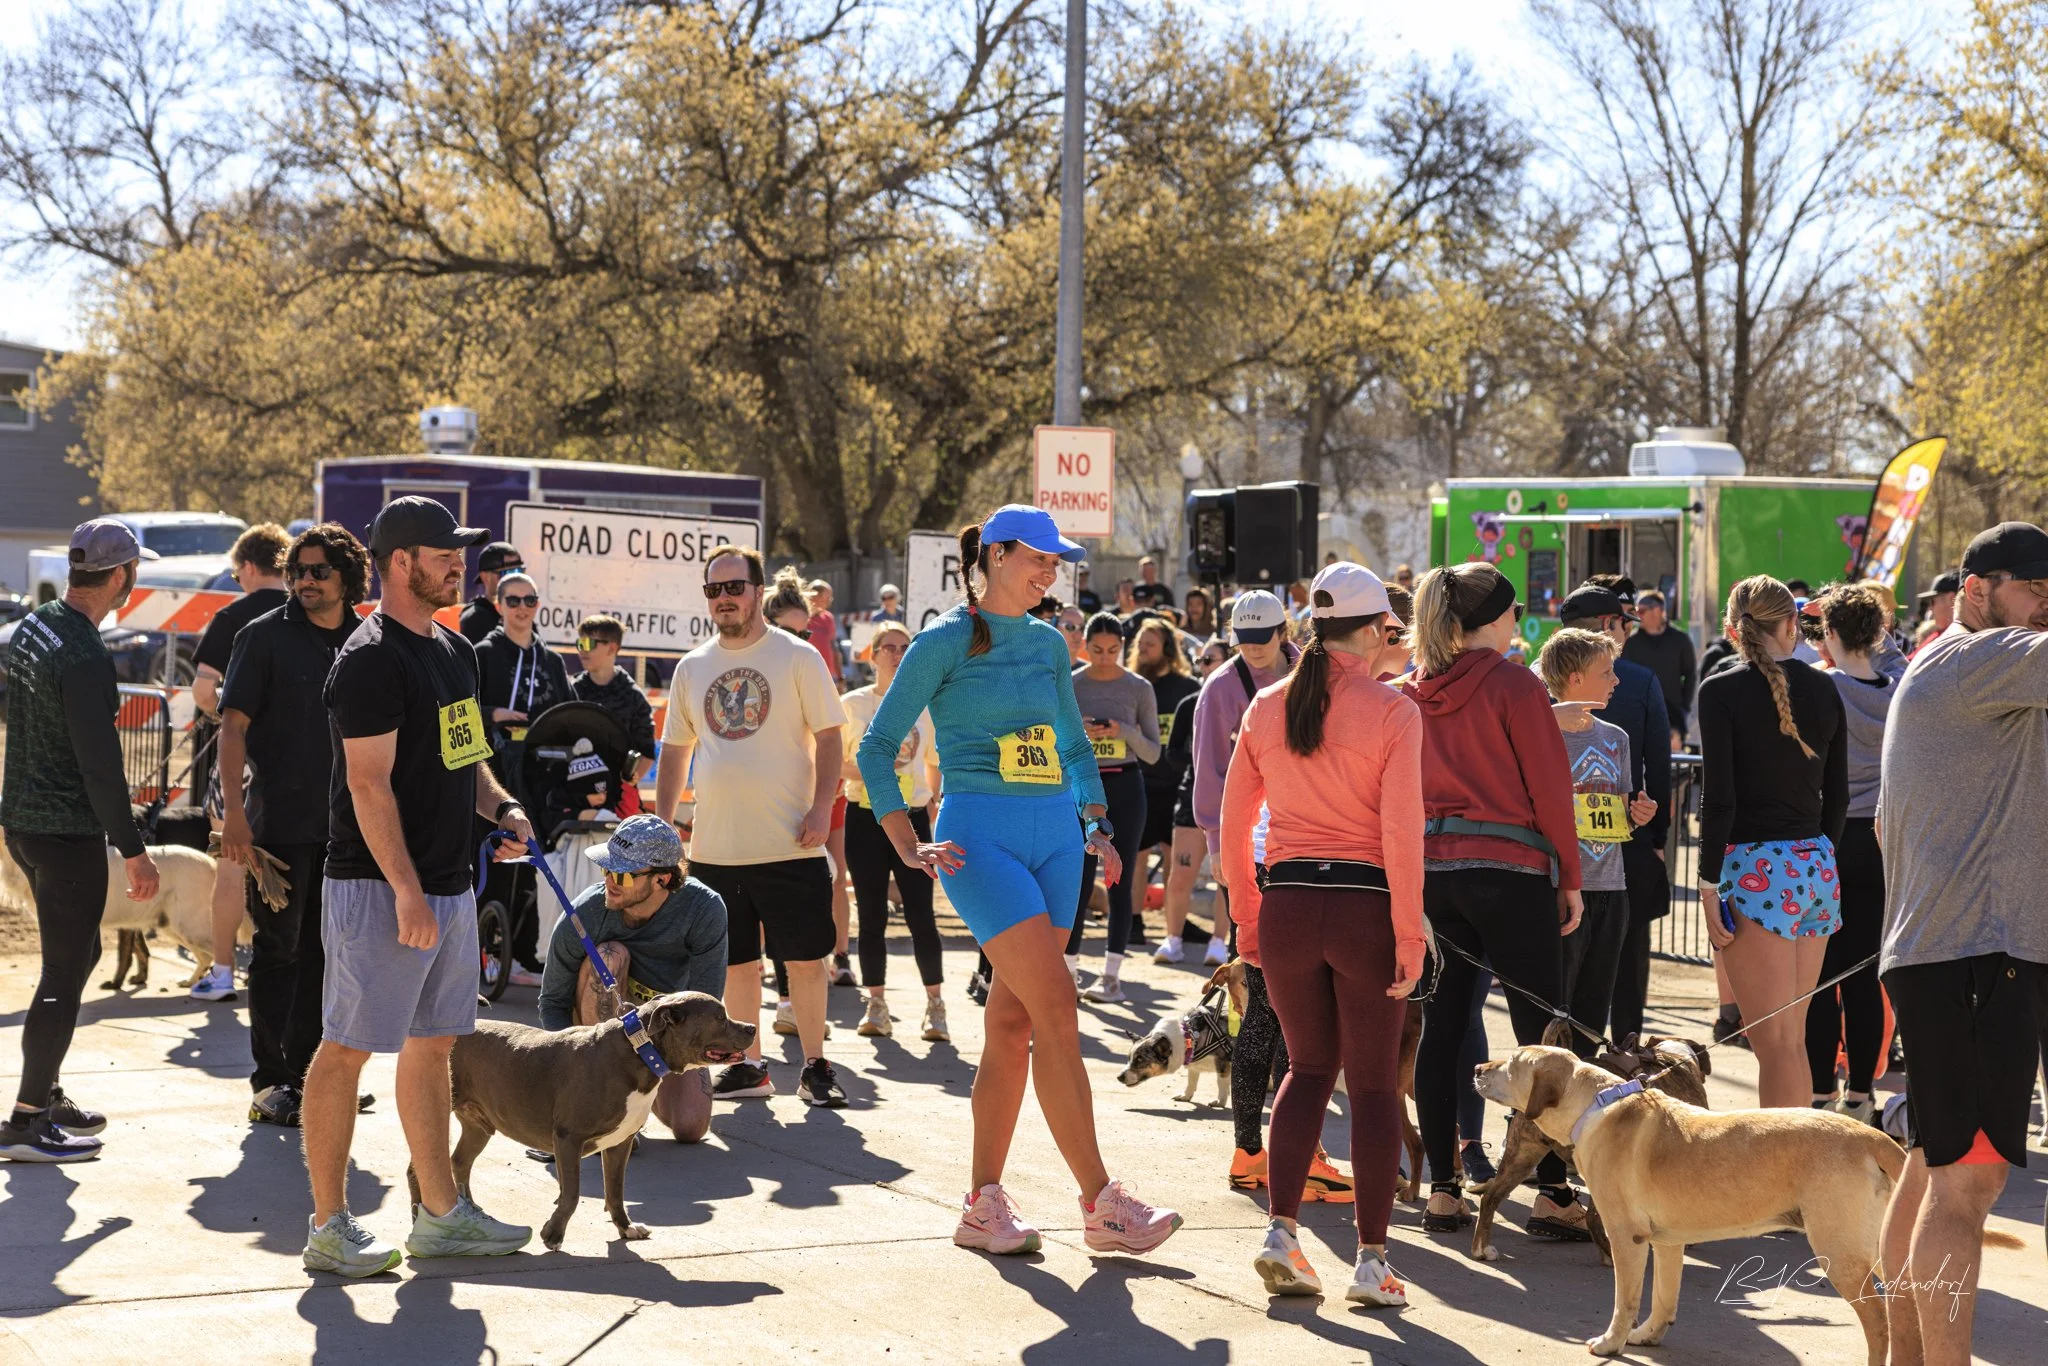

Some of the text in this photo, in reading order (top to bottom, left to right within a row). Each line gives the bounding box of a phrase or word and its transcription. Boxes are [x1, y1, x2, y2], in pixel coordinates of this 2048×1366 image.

[1057, 453, 1091, 477] NO
[1040, 490, 1108, 512] PARKING
[540, 522, 612, 555] ROAD
[536, 606, 582, 630] OCA
[600, 611, 677, 635] AFFIC
[707, 669, 768, 698] HAIR OF THE DOG
[456, 703, 468, 718] 5K
[448, 722, 473, 750] 365
[1033, 728, 1045, 741] 5K
[1016, 744, 1048, 767] 363
[1092, 743, 1115, 756] 205
[1602, 796, 1612, 807] 5K
[1588, 811, 1613, 829] 141
